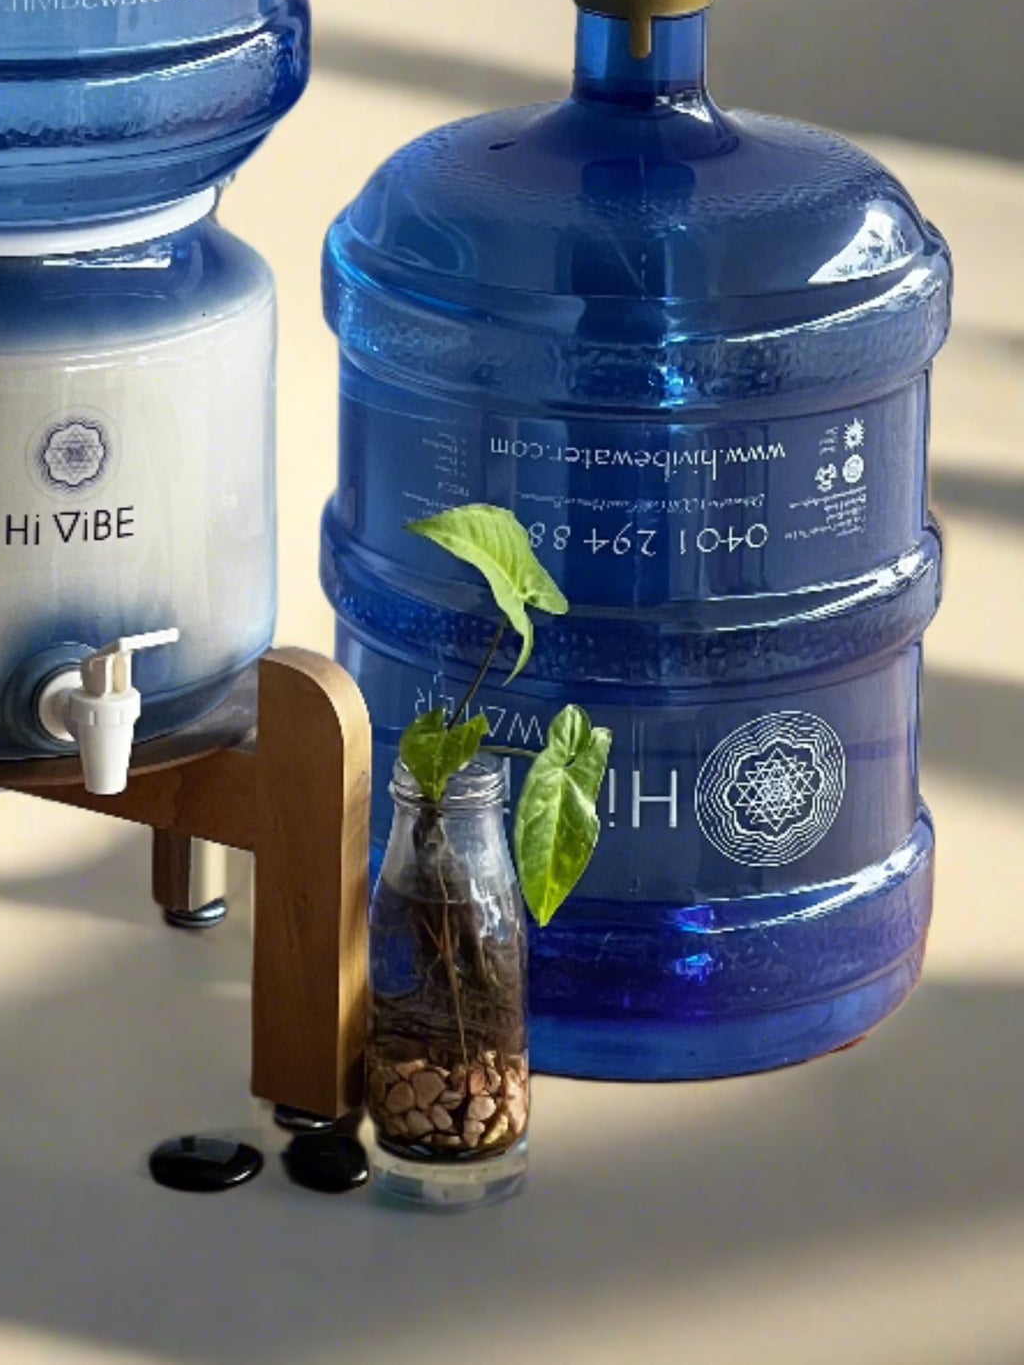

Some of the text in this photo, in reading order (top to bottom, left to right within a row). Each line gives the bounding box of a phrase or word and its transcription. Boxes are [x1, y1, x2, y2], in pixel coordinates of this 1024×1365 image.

[490, 436, 786, 483] www.hivibewater.com
[5, 514, 40, 546] Hi
[583, 521, 657, 556] 294
[679, 522, 770, 555] 0401
[607, 767, 678, 829] Hi
